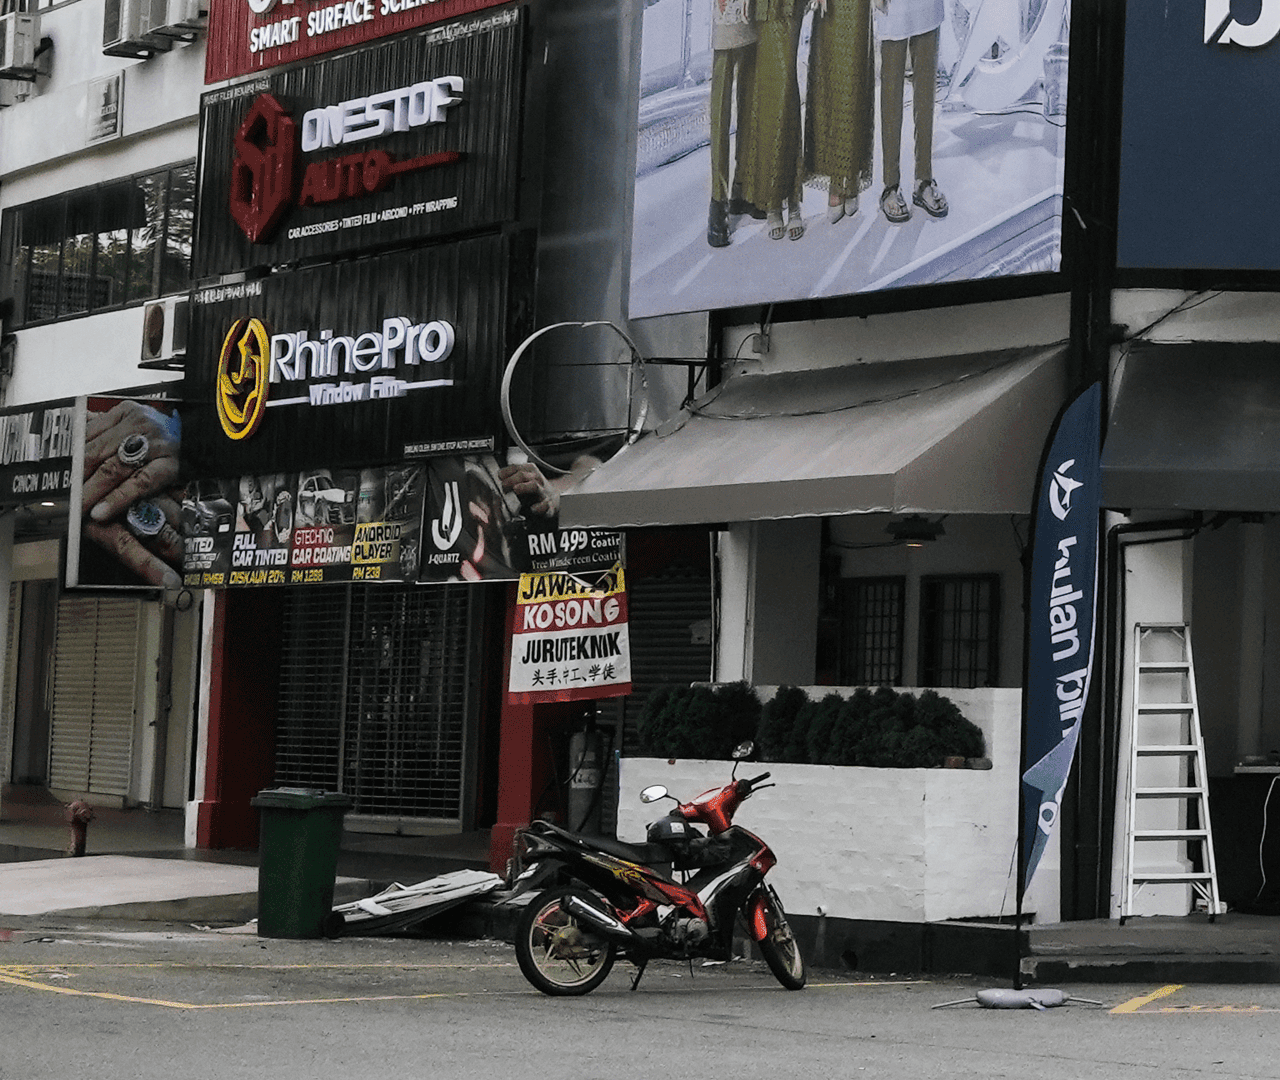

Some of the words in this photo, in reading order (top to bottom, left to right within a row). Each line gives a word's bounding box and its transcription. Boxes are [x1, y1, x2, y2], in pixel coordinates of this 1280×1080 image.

[250, 16, 301, 53] SMART
[301, 75, 464, 152] ONESTOP
[300, 149, 394, 206] AUTO
[288, 228, 300, 240] CAR
[300, 220, 339, 237] ACCESSORIES
[363, 212, 377, 225] FILM
[425, 196, 458, 213] WRAPPING
[269, 316, 455, 383] RhinePro
[309, 381, 370, 406] Window
[370, 375, 408, 399] Film
[41, 470, 61, 491] DAN
[232, 533, 257, 550] FULL
[355, 524, 401, 543] ANDROID
[528, 532, 557, 556] RM
[560, 530, 588, 552] 499
[231, 550, 254, 567] CAR
[255, 548, 288, 566] TINTED
[291, 548, 313, 564] CAR
[313, 545, 351, 563] COATING
[354, 542, 393, 560] PLAYER
[427, 553, 460, 565] J-QUARTZ
[523, 598, 620, 630] KOSONG
[522, 632, 622, 664] JURUTEKNIK
